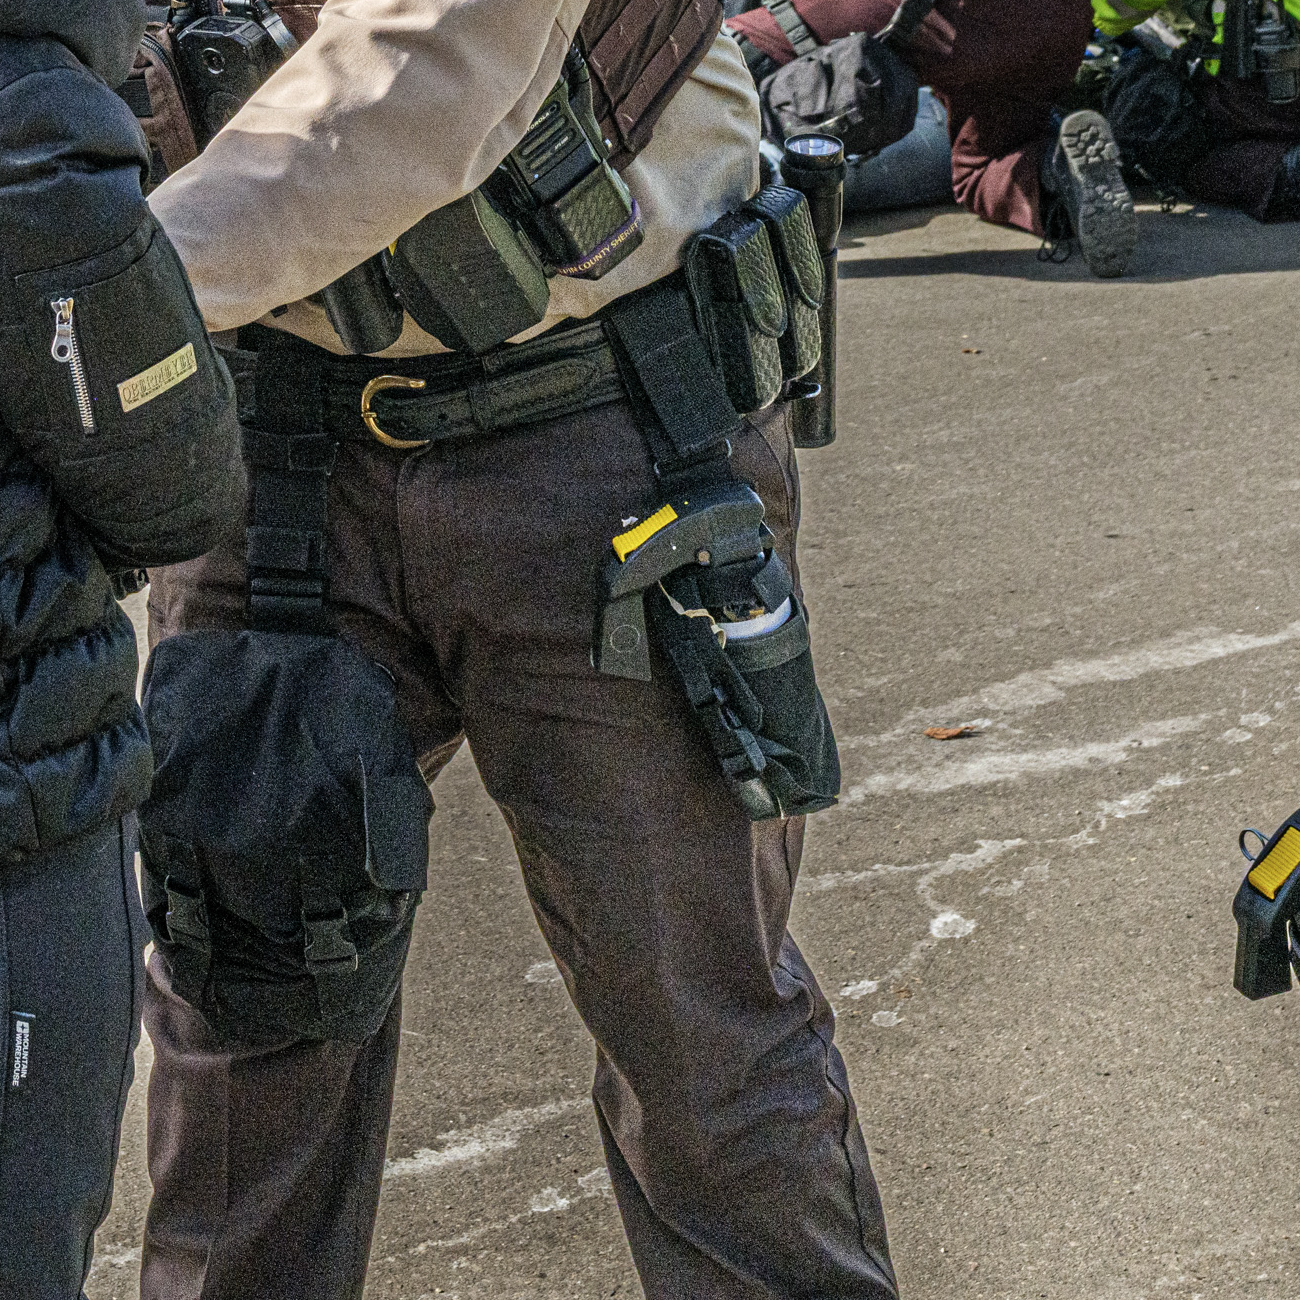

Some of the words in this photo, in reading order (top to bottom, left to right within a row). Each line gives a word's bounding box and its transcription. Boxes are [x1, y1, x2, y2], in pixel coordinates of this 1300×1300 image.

[578, 245, 611, 271] COUNTY
[12, 1033, 23, 1087] WAREHOUSE
[20, 1033, 30, 1079] MOUNTAIN
